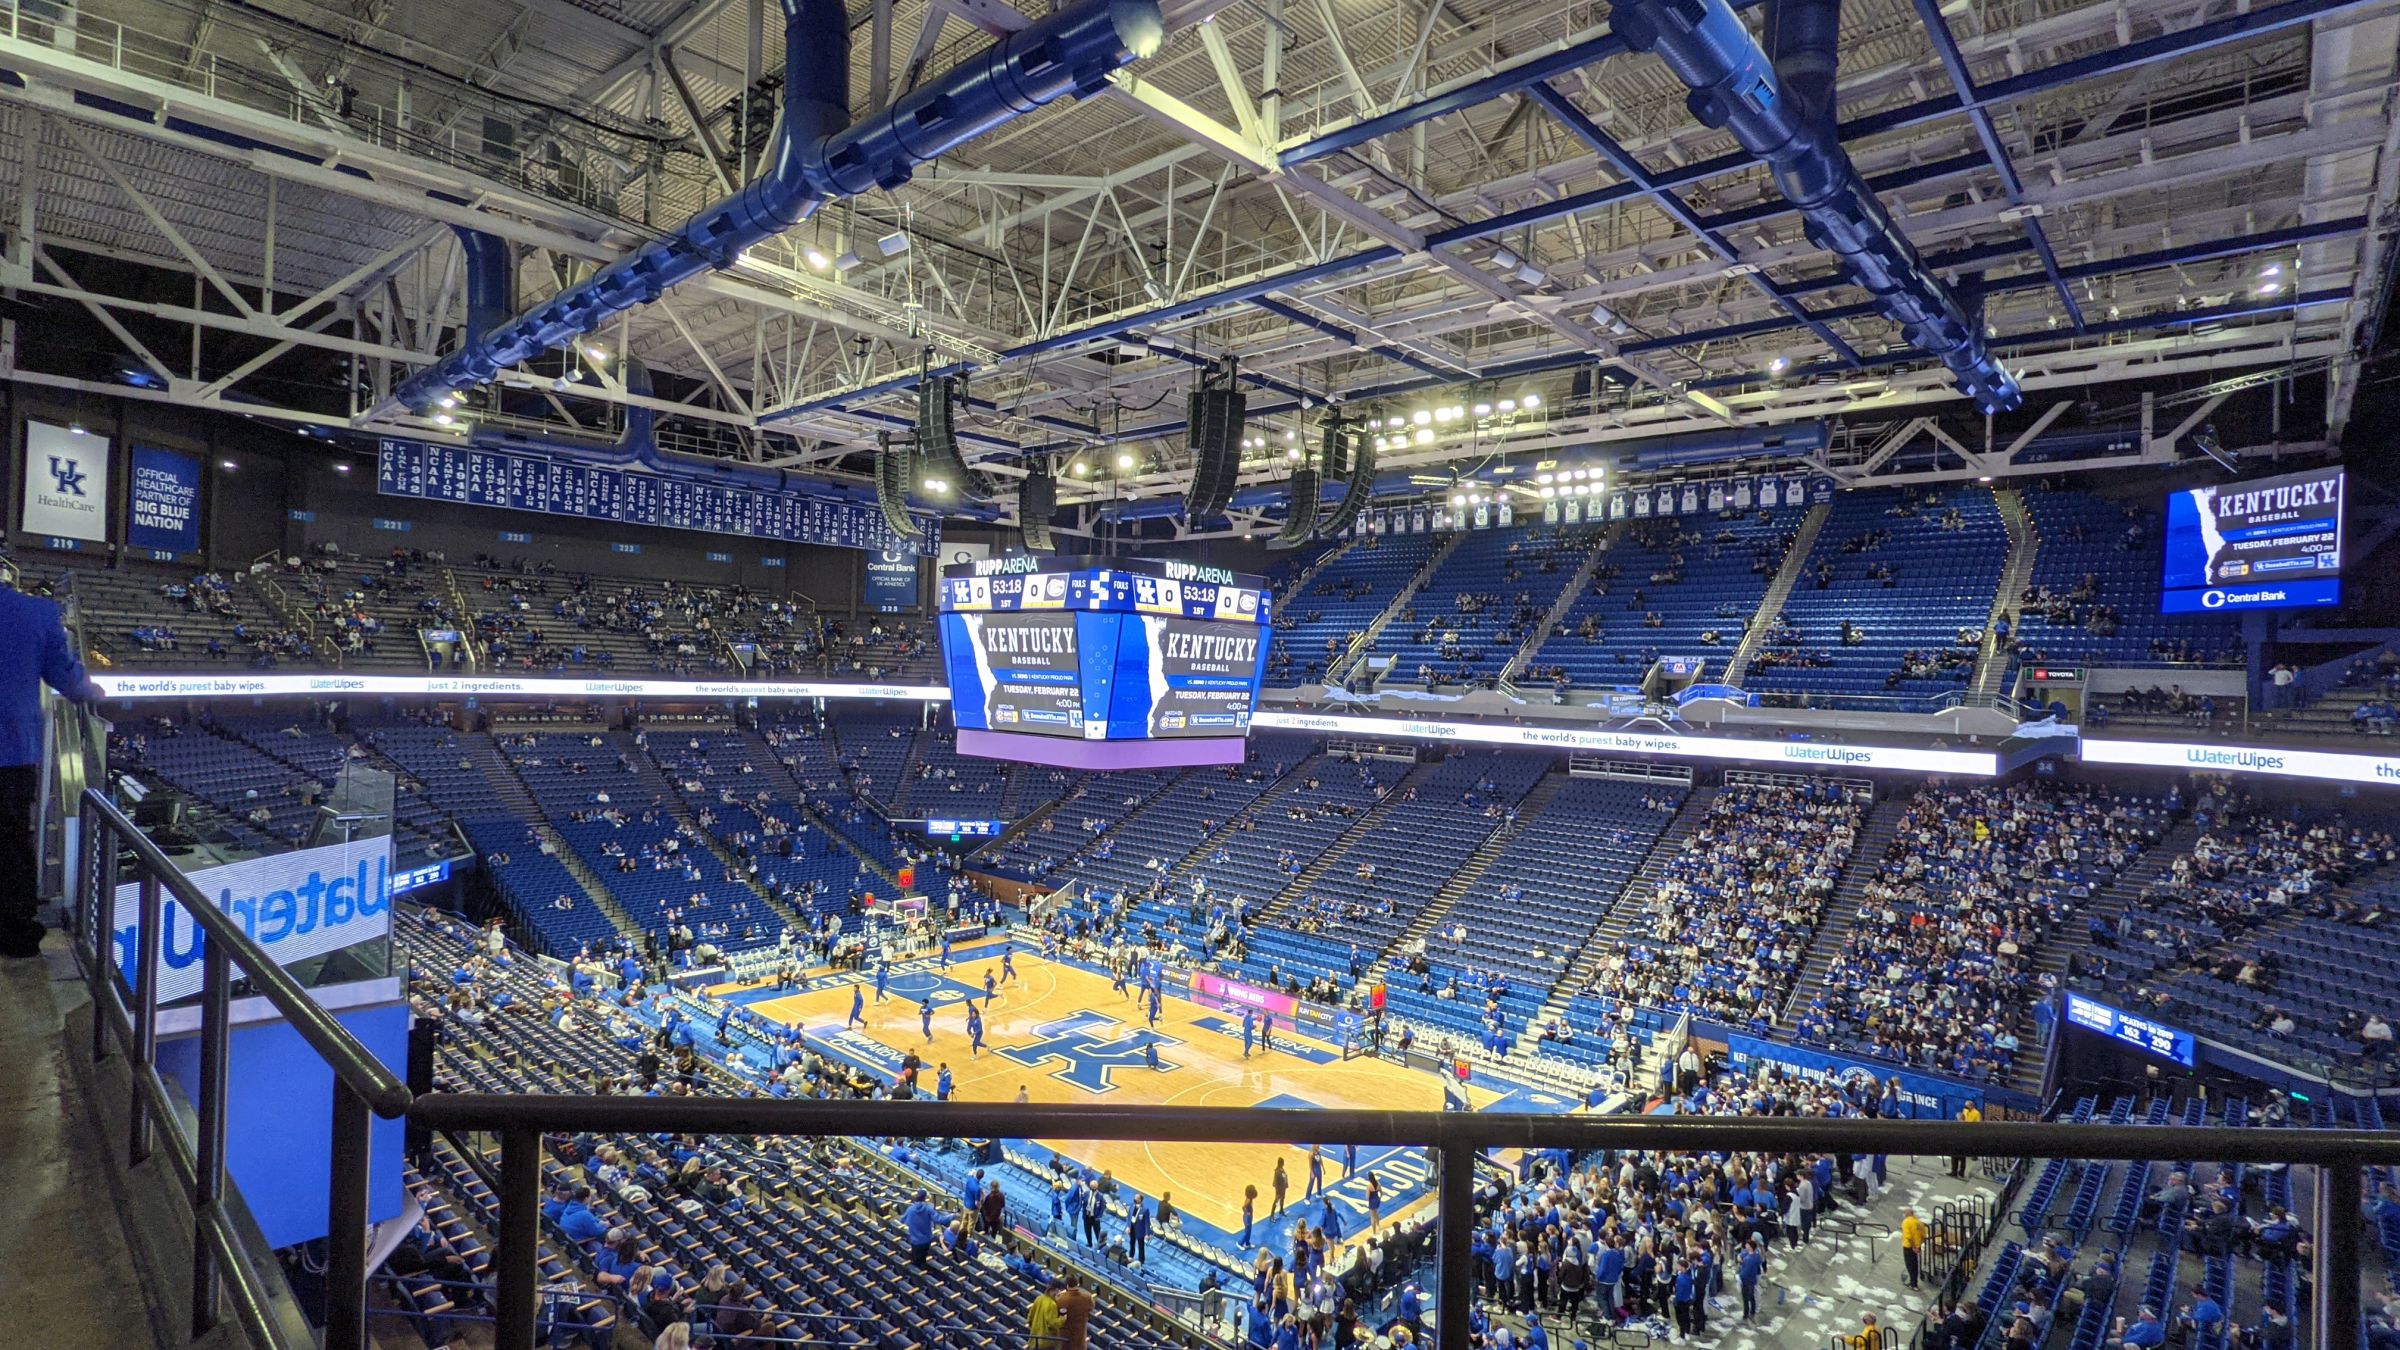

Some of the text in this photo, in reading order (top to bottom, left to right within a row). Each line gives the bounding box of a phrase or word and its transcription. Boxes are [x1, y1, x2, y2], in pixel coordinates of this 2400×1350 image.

[382, 442, 394, 480] NCAA
[428, 447, 440, 485] NCAA
[137, 467, 178, 484] OFFICIAL
[410, 456, 420, 493] 1942
[443, 452, 453, 496] CHAMPION
[456, 463, 465, 499] 1948
[471, 454, 482, 492] NCAA
[485, 458, 496, 501] CHAMPION
[512, 460, 522, 496] NCAA
[136, 478, 194, 497] HEALTHCARE
[496, 470, 505, 504] 1949
[526, 464, 534, 506] CHAMPION
[538, 475, 546, 509] 1951
[551, 466, 562, 501] NCAA
[564, 470, 572, 510] CHAMPION
[589, 471, 599, 506] NCAA
[136, 489, 191, 506] PARTNER OF
[575, 479, 583, 512] 1958
[611, 485, 620, 518] 1966
[627, 477, 636, 511] NCAA
[664, 482, 672, 516] NCAA
[2220, 480, 2334, 518] KENTUCKY
[38, 494, 95, 512] HealthCare
[136, 500, 190, 519] BIG BLUE
[648, 490, 656, 522] 1975
[694, 487, 704, 520] NCAA
[756, 495, 764, 526] NCAA
[135, 514, 183, 531] NATION
[785, 500, 793, 530] NCAA
[814, 503, 822, 533] NCAA
[2249, 511, 2299, 523] BASEBALL
[384, 520, 402, 530] 221
[53, 538, 73, 549] 219
[2233, 540, 2272, 550] TUESDAY,
[2273, 534, 2320, 546] FEBRUARY
[154, 551, 172, 560] 219
[868, 563, 916, 572] Central Bank
[977, 586, 983, 598] 0
[992, 579, 1022, 594] 53:18
[1031, 584, 1038, 596] 0
[1114, 581, 1128, 589] FOULS
[1118, 592, 1124, 600] 0
[1166, 590, 1173, 602] 0
[1184, 586, 1215, 602] 53:18
[1224, 597, 1231, 608] 0
[2227, 590, 2286, 602] Central Bank
[987, 628, 1074, 653] KENTUCKY
[1166, 633, 1256, 661] KENTUCKY
[1012, 657, 1050, 665] BASEBALL
[1191, 663, 1229, 672] BASEBALL
[117, 680, 136, 692] the
[139, 680, 177, 692] world's
[179, 682, 212, 694] purest
[214, 680, 236, 693] baby
[310, 680, 364, 690] WaterWipes
[427, 681, 523, 692] just 2 ingredients.
[585, 682, 643, 693] WaterWipes
[696, 684, 708, 692] the
[711, 685, 739, 693] world's
[741, 686, 766, 694] purest
[768, 686, 785, 694] baby
[859, 687, 907, 696] WaterWipes
[1003, 685, 1033, 695] TUESDAY,
[1034, 686, 1068, 696] FEBRUARY
[1175, 691, 1206, 700] TUESDAY,
[1207, 692, 1240, 700] FEBRUARY
[1276, 716, 1290, 726] just
[1297, 718, 1338, 729] ingredients
[1402, 723, 1456, 736] WaterWipes
[1523, 732, 1680, 750] the world's purest baby wipes.
[1785, 746, 1872, 763] WaterWipes
[2187, 748, 2283, 769] WaterWipes
[2376, 762, 2400, 778] the
[2119, 1014, 2147, 1031] DEATHS
[2124, 1026, 2140, 1039] 162
[2152, 1036, 2171, 1050] 290
